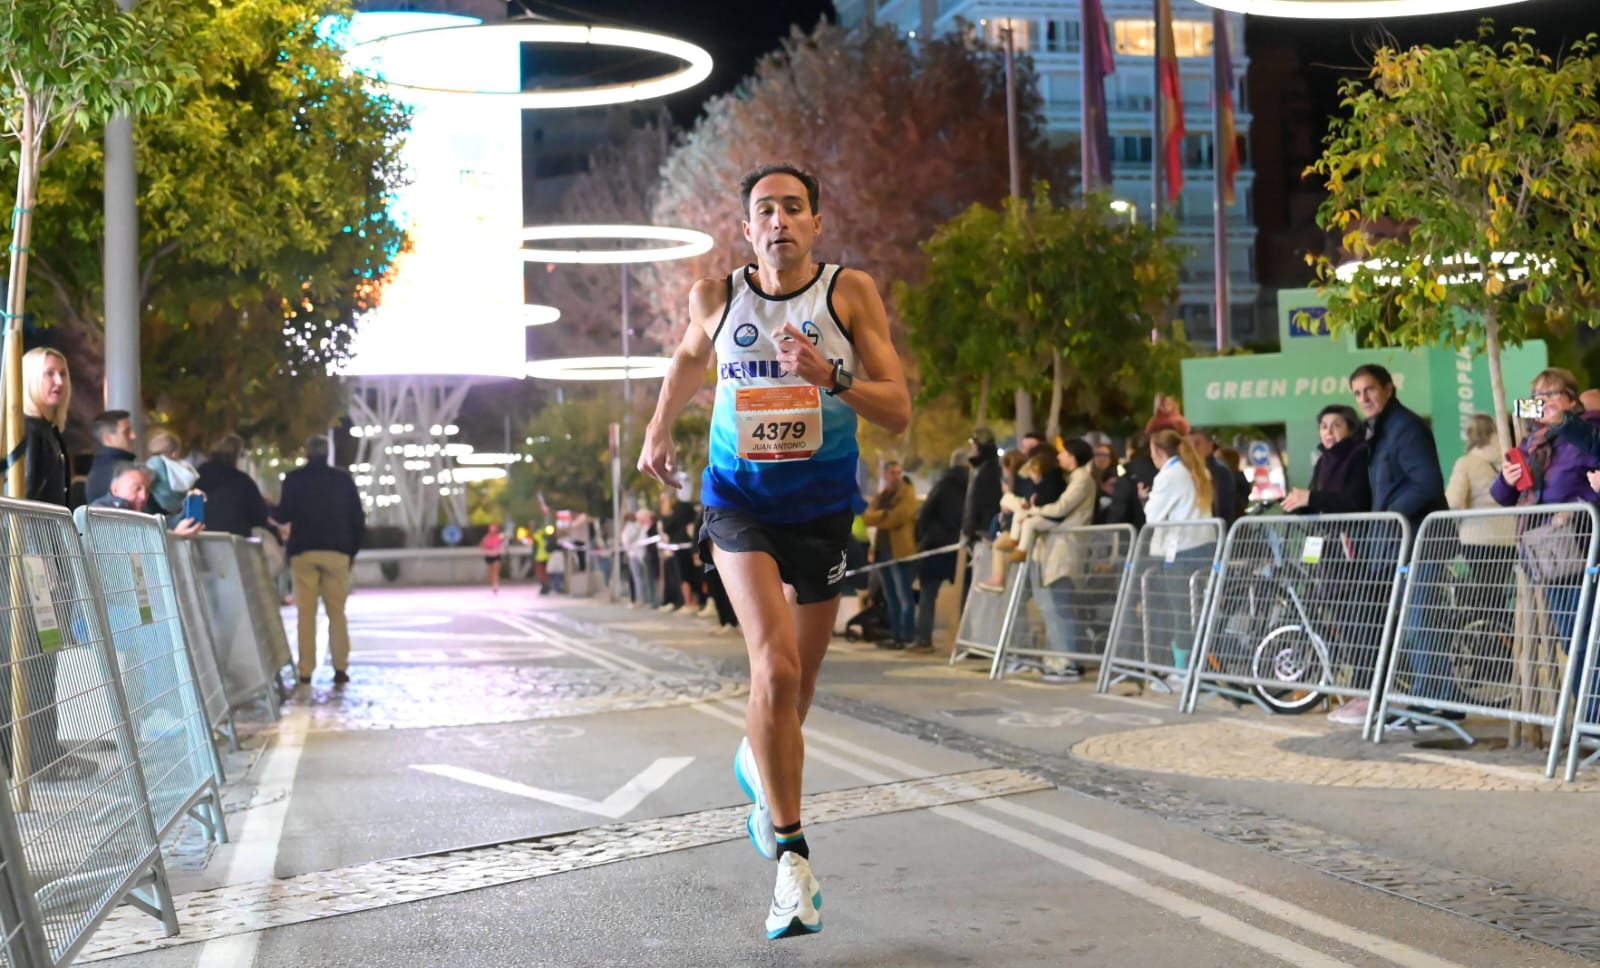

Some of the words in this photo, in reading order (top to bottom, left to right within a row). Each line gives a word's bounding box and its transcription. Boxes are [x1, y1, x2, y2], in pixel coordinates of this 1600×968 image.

[1206, 378, 1288, 400] GREEN
[1294, 373, 1405, 396] PIONR
[752, 421, 806, 441] 4379
[752, 442, 772, 451] JUAN
[773, 441, 806, 451] ANTONIO
